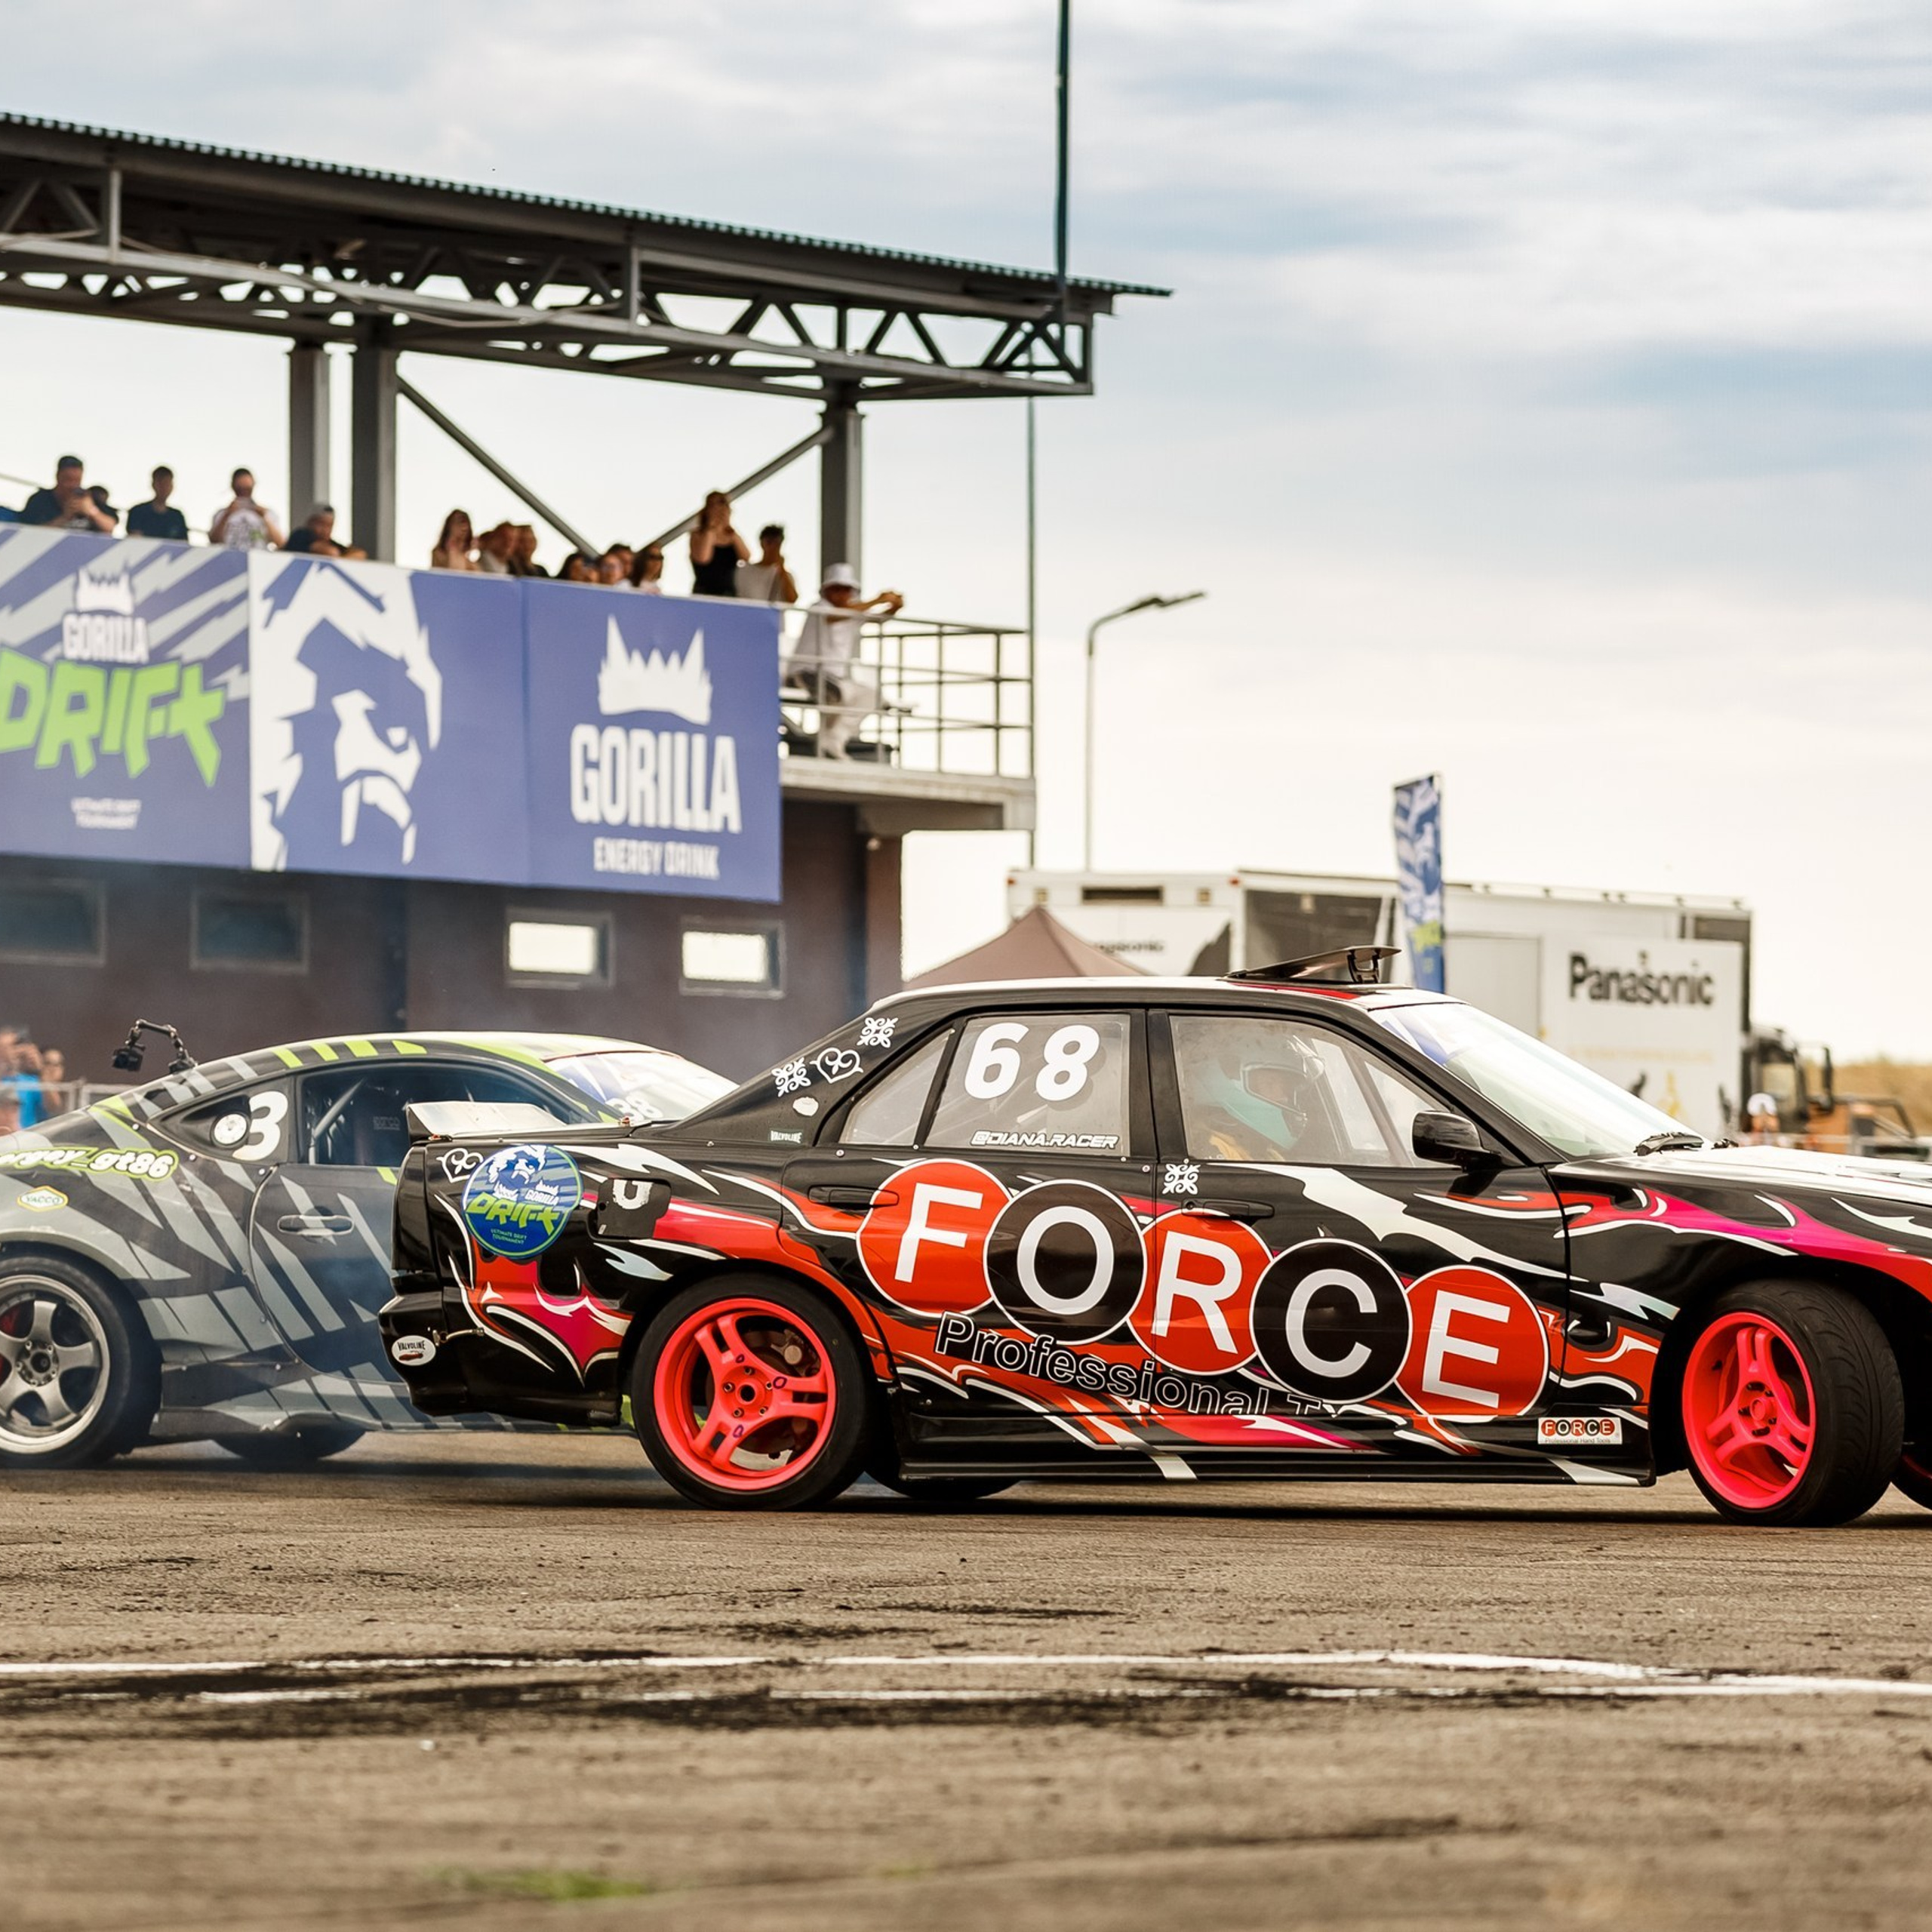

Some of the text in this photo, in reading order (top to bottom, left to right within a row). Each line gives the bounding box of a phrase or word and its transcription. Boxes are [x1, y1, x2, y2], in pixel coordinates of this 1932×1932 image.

[63, 613, 149, 664] GORILLA
[570, 723, 743, 835] GORILLA
[593, 836, 721, 881] ENERGY DRINK
[1569, 952, 1714, 1007] Panasonic
[964, 1022, 1100, 1102] 68
[971, 1130, 1119, 1149] @DIANA.RACER
[525, 1189, 559, 1206] GORILLA
[894, 1183, 1510, 1409] FORCE
[934, 1311, 1269, 1415] Professional
[1543, 1421, 1613, 1435] FORCE
